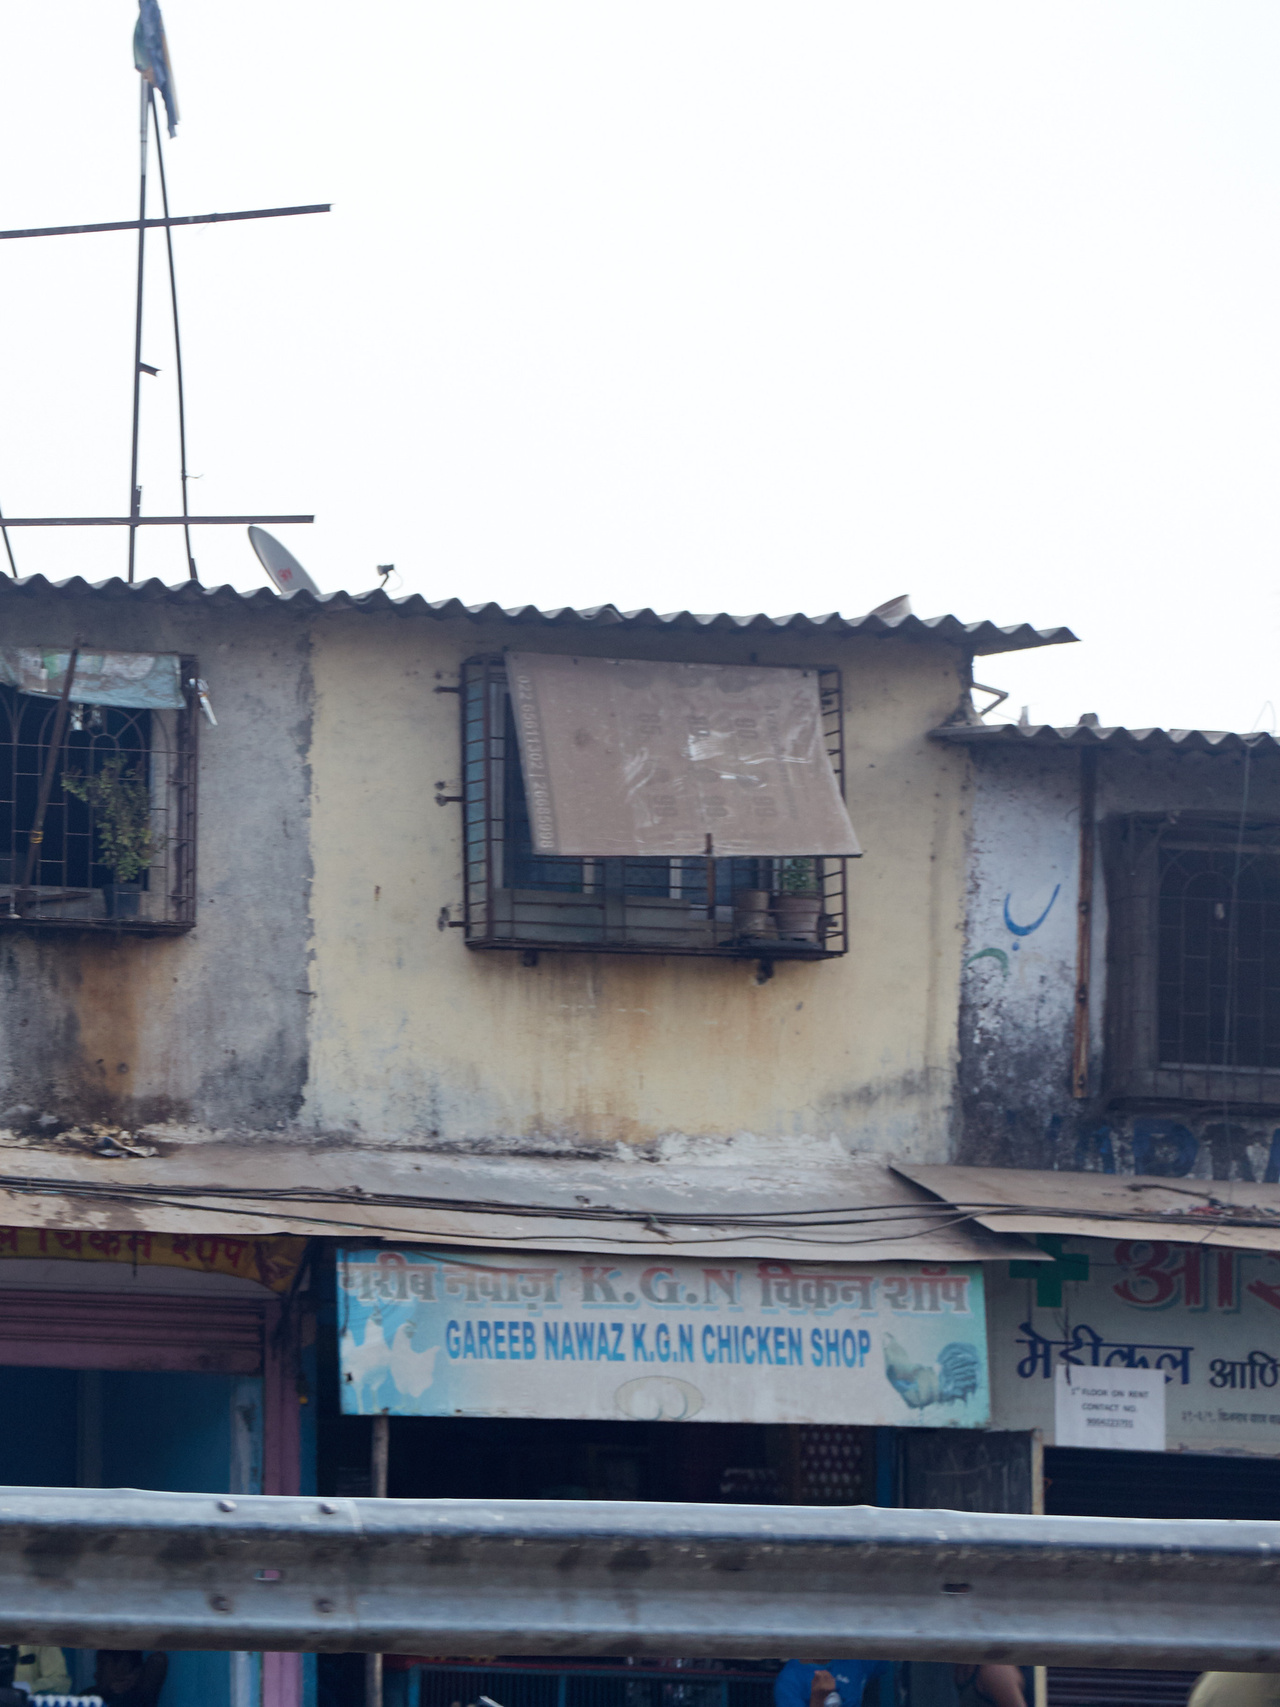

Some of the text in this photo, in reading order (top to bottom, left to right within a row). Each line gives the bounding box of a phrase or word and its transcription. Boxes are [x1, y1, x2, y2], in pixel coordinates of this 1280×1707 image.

[337, 1252, 438, 1301] गरीब
[578, 1265, 737, 1306] K.G.N
[756, 1261, 875, 1311] चिकन
[882, 1266, 970, 1312] शॉप
[445, 1319, 872, 1369] GAREEB NAWAZ K.G.N CHICKEN SHOP
